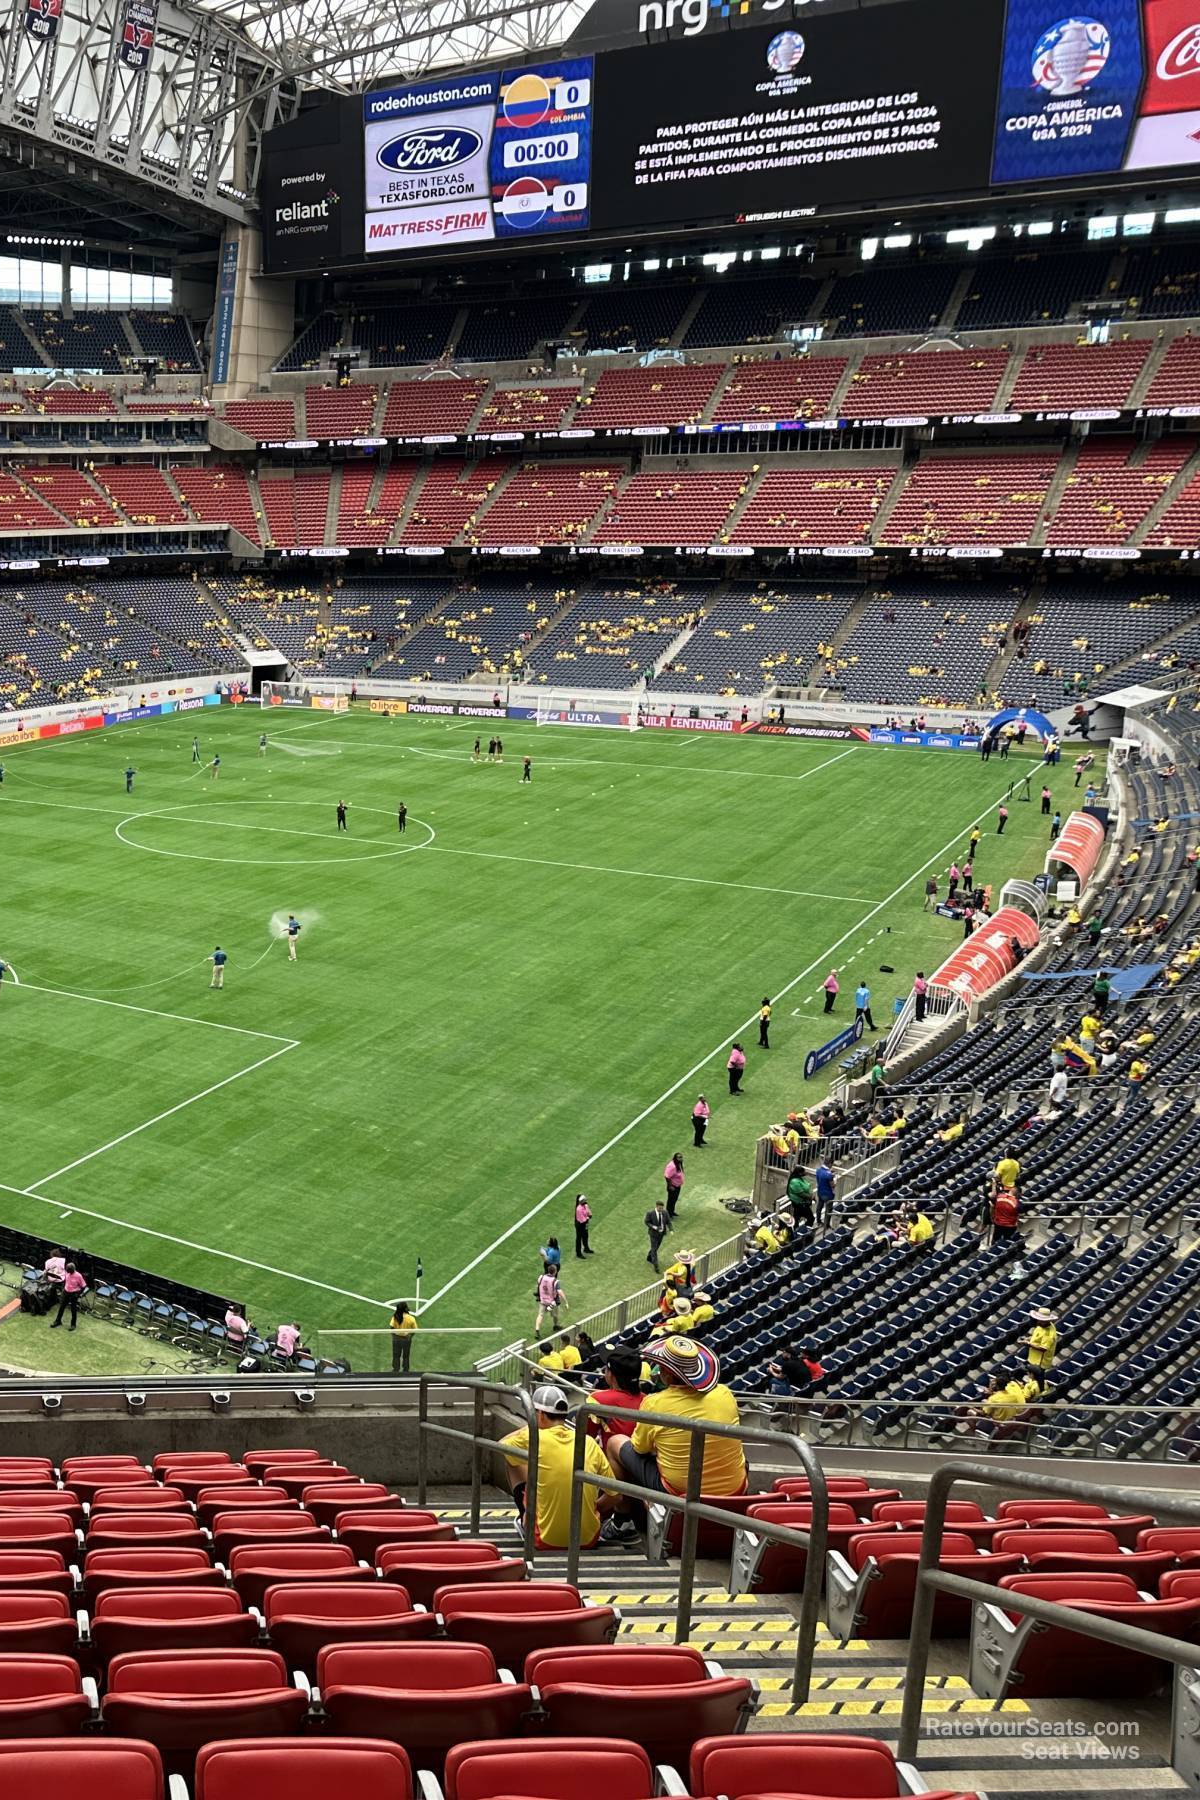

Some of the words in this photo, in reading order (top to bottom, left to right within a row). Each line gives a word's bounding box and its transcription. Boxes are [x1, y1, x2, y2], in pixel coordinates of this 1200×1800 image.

[129, 9, 154, 25] CHAMPIONS
[639, 0, 708, 35] nrg
[32, 18, 50, 34] 2018
[127, 50, 142, 64] 2019
[567, 86, 578, 104] 0
[756, 82, 776, 92] COPA
[371, 84, 492, 113] rodeohouston.com
[1046, 99, 1083, 112] CONMEBOL
[550, 112, 586, 124] COLOMBIA
[656, 126, 683, 138] PARA
[685, 118, 738, 134] PROTEGER
[740, 113, 764, 126] AÚN
[766, 109, 789, 123] MÁS
[791, 108, 805, 120] LA
[806, 98, 874, 118] INTEGRIDAD
[877, 96, 892, 108] DE
[894, 92, 918, 104] LOS
[1006, 113, 1047, 131] COPA
[1050, 104, 1122, 126] AMERICA
[639, 139, 692, 155] PARTIDOS,
[693, 132, 742, 148] DURANTE
[744, 130, 757, 141] LA
[759, 122, 820, 139] CONMEBOL
[821, 118, 852, 131] COPA
[853, 111, 905, 127] AMÉRICA
[906, 105, 937, 120] 2024
[1032, 128, 1056, 141] USA
[1060, 124, 1092, 138] 2024
[397, 132, 461, 168] Ford
[514, 139, 568, 163] 00:00
[635, 160, 647, 170] SE
[649, 155, 674, 168] ESTÁ
[675, 144, 764, 165] IMPLEMENTANDO
[766, 143, 778, 154] EL
[780, 130, 872, 151] PROCEDIMIENTO
[874, 128, 889, 140] DE
[891, 127, 900, 138] 3
[901, 121, 941, 136] PASOS
[635, 174, 648, 185] DE
[650, 172, 663, 183] LA
[664, 170, 686, 181] FIFA
[688, 166, 714, 179] PARA
[716, 152, 823, 175] COMPORTAMIENTOS
[825, 138, 939, 162] DISCRIMINATORIOS.
[281, 172, 315, 187] powered
[316, 172, 325, 182] by
[389, 180, 415, 191] BEST
[418, 178, 428, 188] IN
[430, 173, 465, 185] TEXAS
[379, 184, 475, 204] TEXASFORD.COM
[564, 190, 576, 207] 0
[276, 200, 329, 222] reliant
[783, 208, 815, 218] ELECTRIC
[285, 226, 299, 234] NRG
[300, 224, 328, 233] company
[180, 699, 203, 710] Rexona
[408, 704, 454, 714] POWERADE
[459, 707, 506, 717] POWERADE
[567, 712, 600, 722] ULTRA
[670, 717, 733, 731] CENTENARIO
[20, 730, 34, 740] libre
[786, 727, 845, 737] RAPIDISIMO
